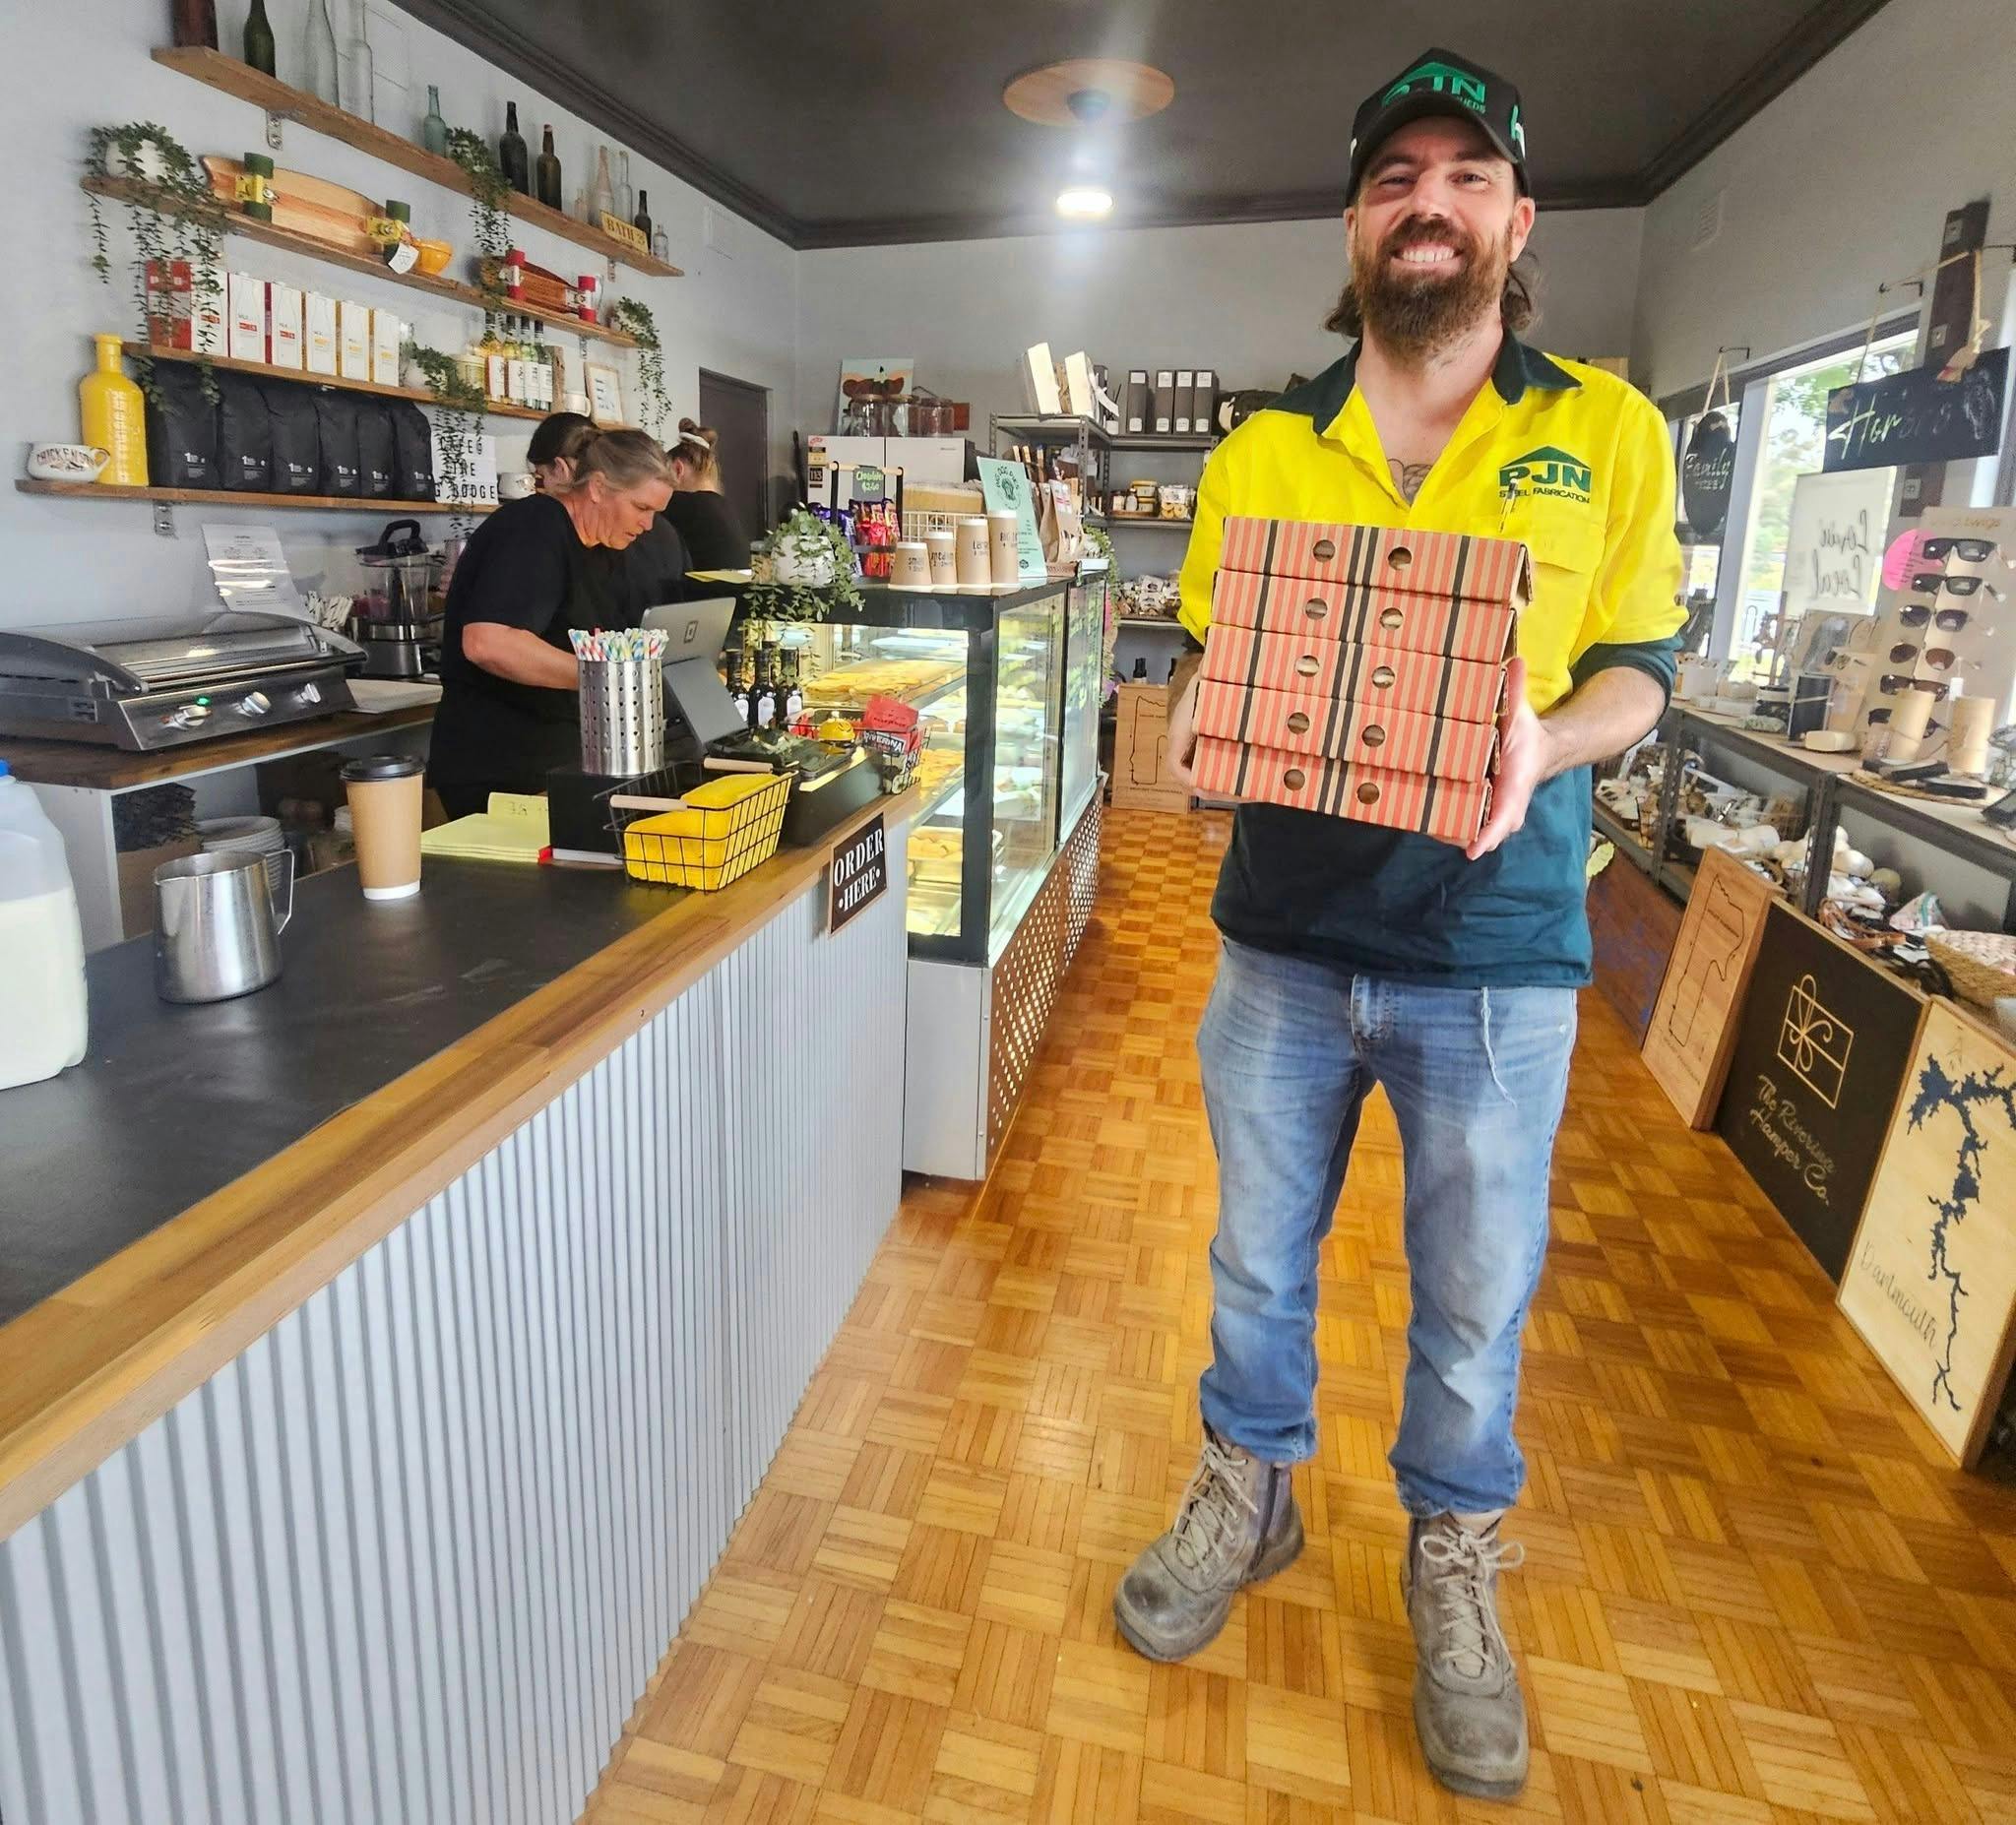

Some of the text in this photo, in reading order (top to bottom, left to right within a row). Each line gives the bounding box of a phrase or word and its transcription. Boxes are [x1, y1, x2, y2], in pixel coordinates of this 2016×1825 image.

[1499, 462, 1592, 494] PJN
[1532, 486, 1591, 504] FABRICATION
[834, 828, 884, 887] ORDER
[1749, 1108, 1801, 1170] Hamper
[1859, 1237, 1937, 1349] Dartmouth
